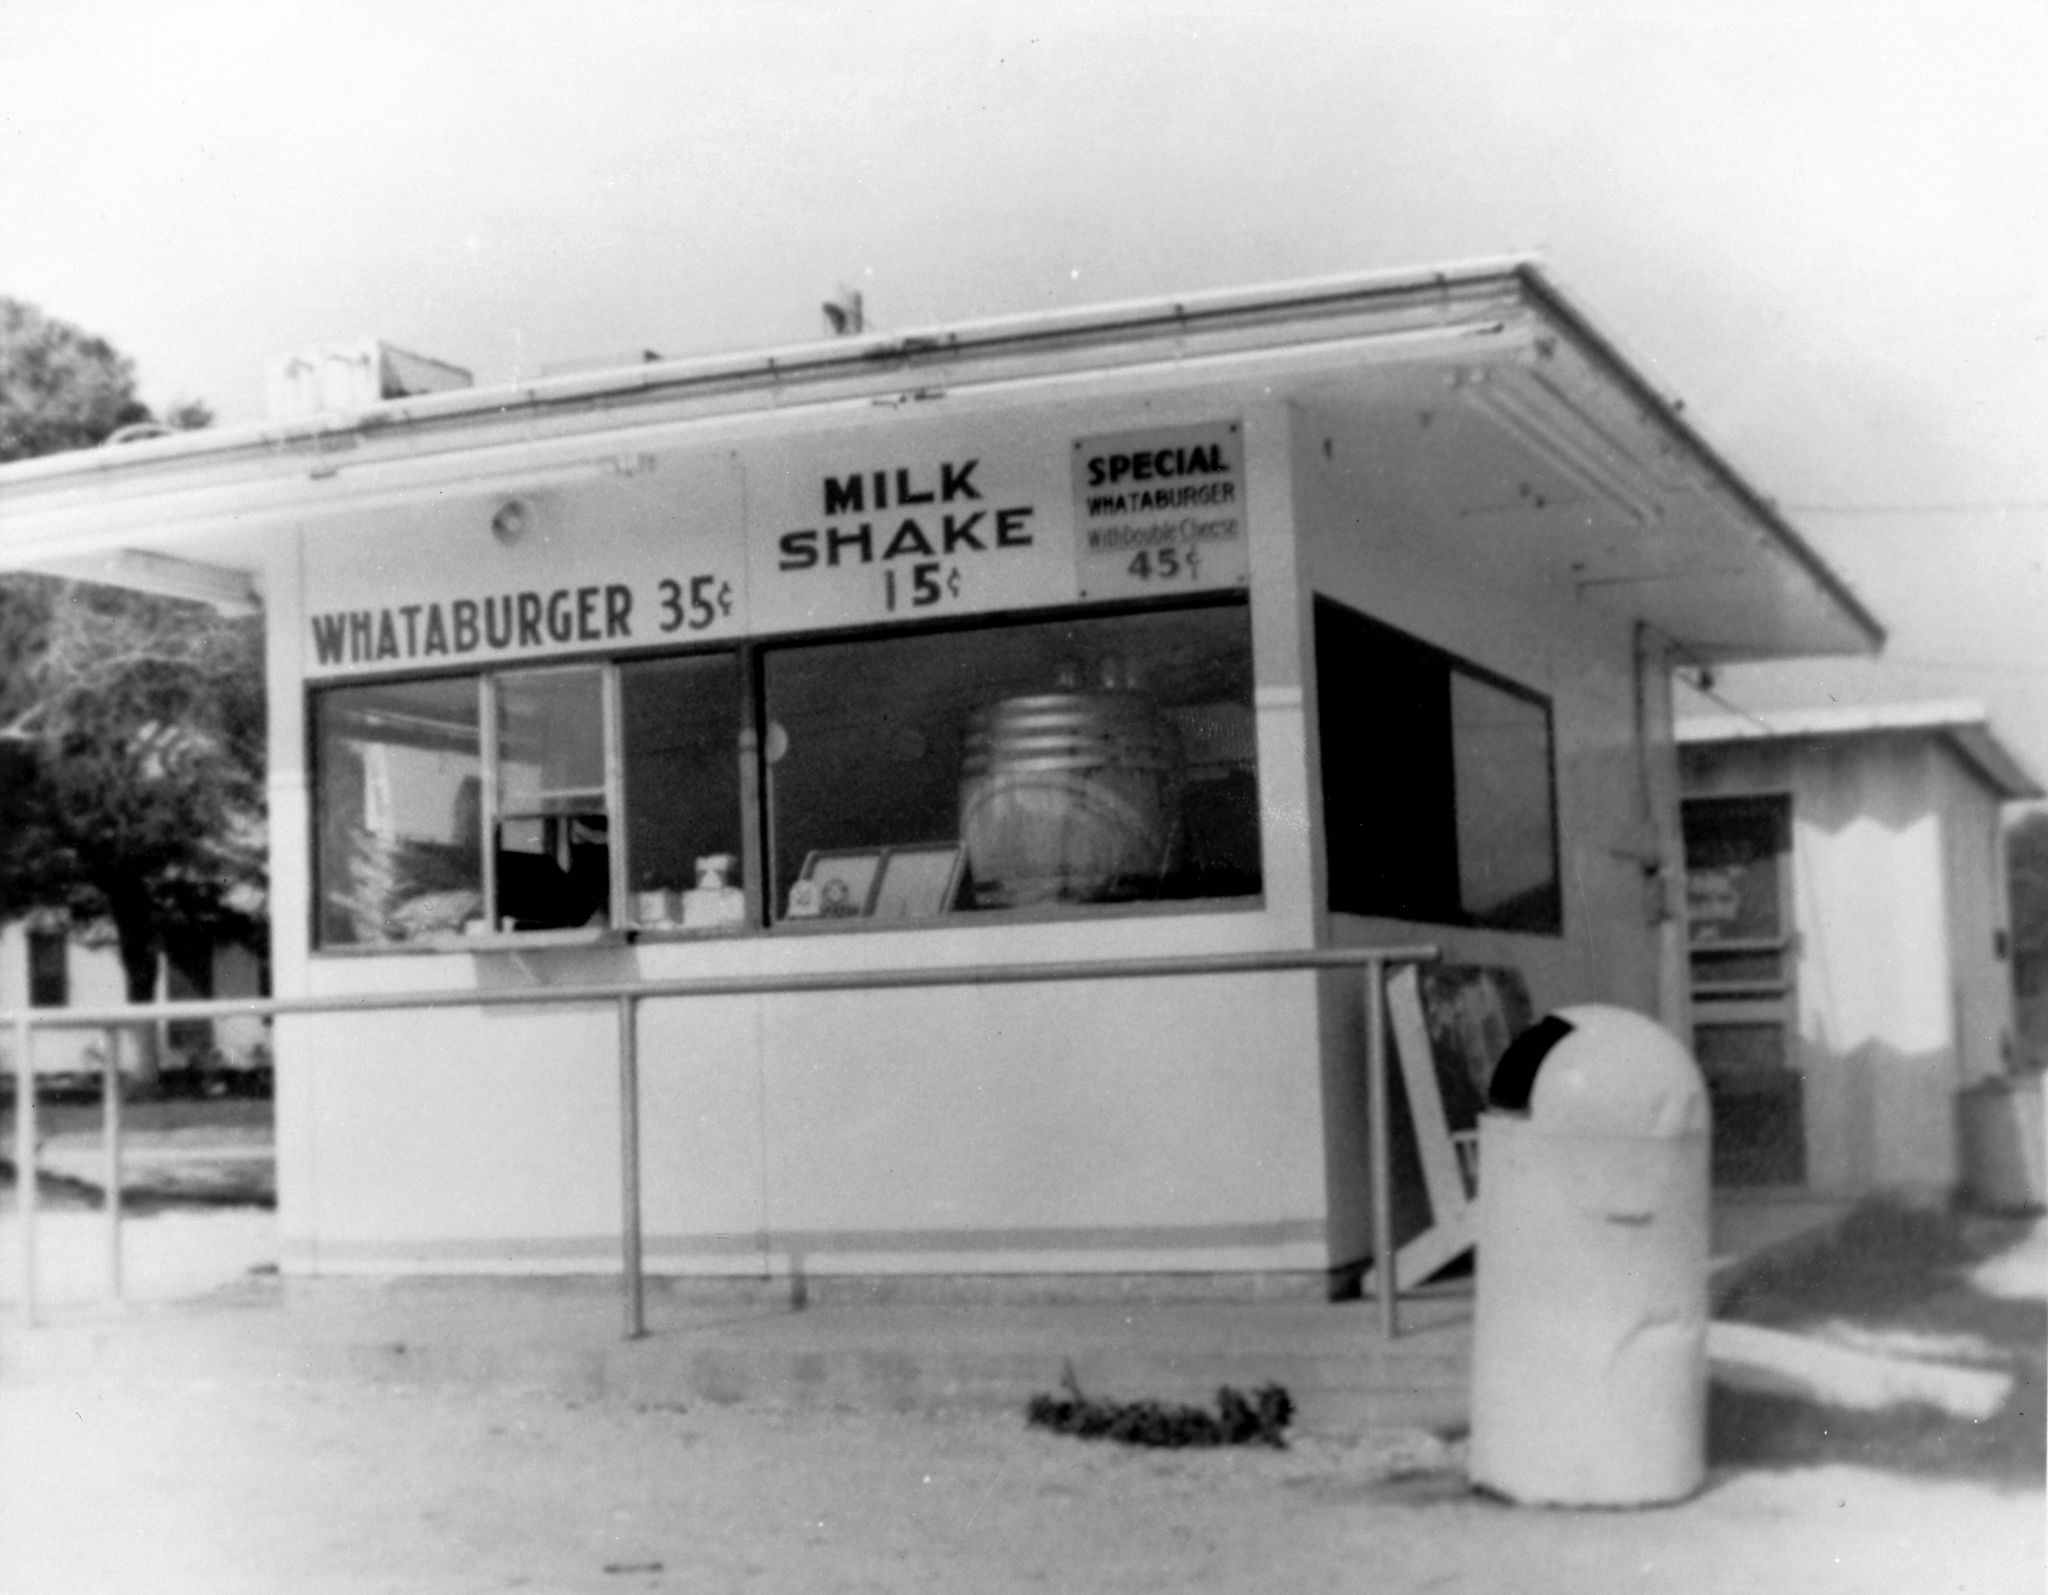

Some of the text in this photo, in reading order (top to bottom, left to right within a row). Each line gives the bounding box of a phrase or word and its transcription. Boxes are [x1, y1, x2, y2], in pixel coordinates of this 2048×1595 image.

[823, 458, 983, 516] MILK
[1088, 443, 1230, 487] SPECIAL
[1087, 481, 1235, 518] WHATABURGER
[779, 506, 1034, 571] SHAKE
[1127, 544, 1200, 580] 45¢
[884, 562, 961, 612] 15¢
[311, 575, 733, 666] WHATABURGER 35¢
